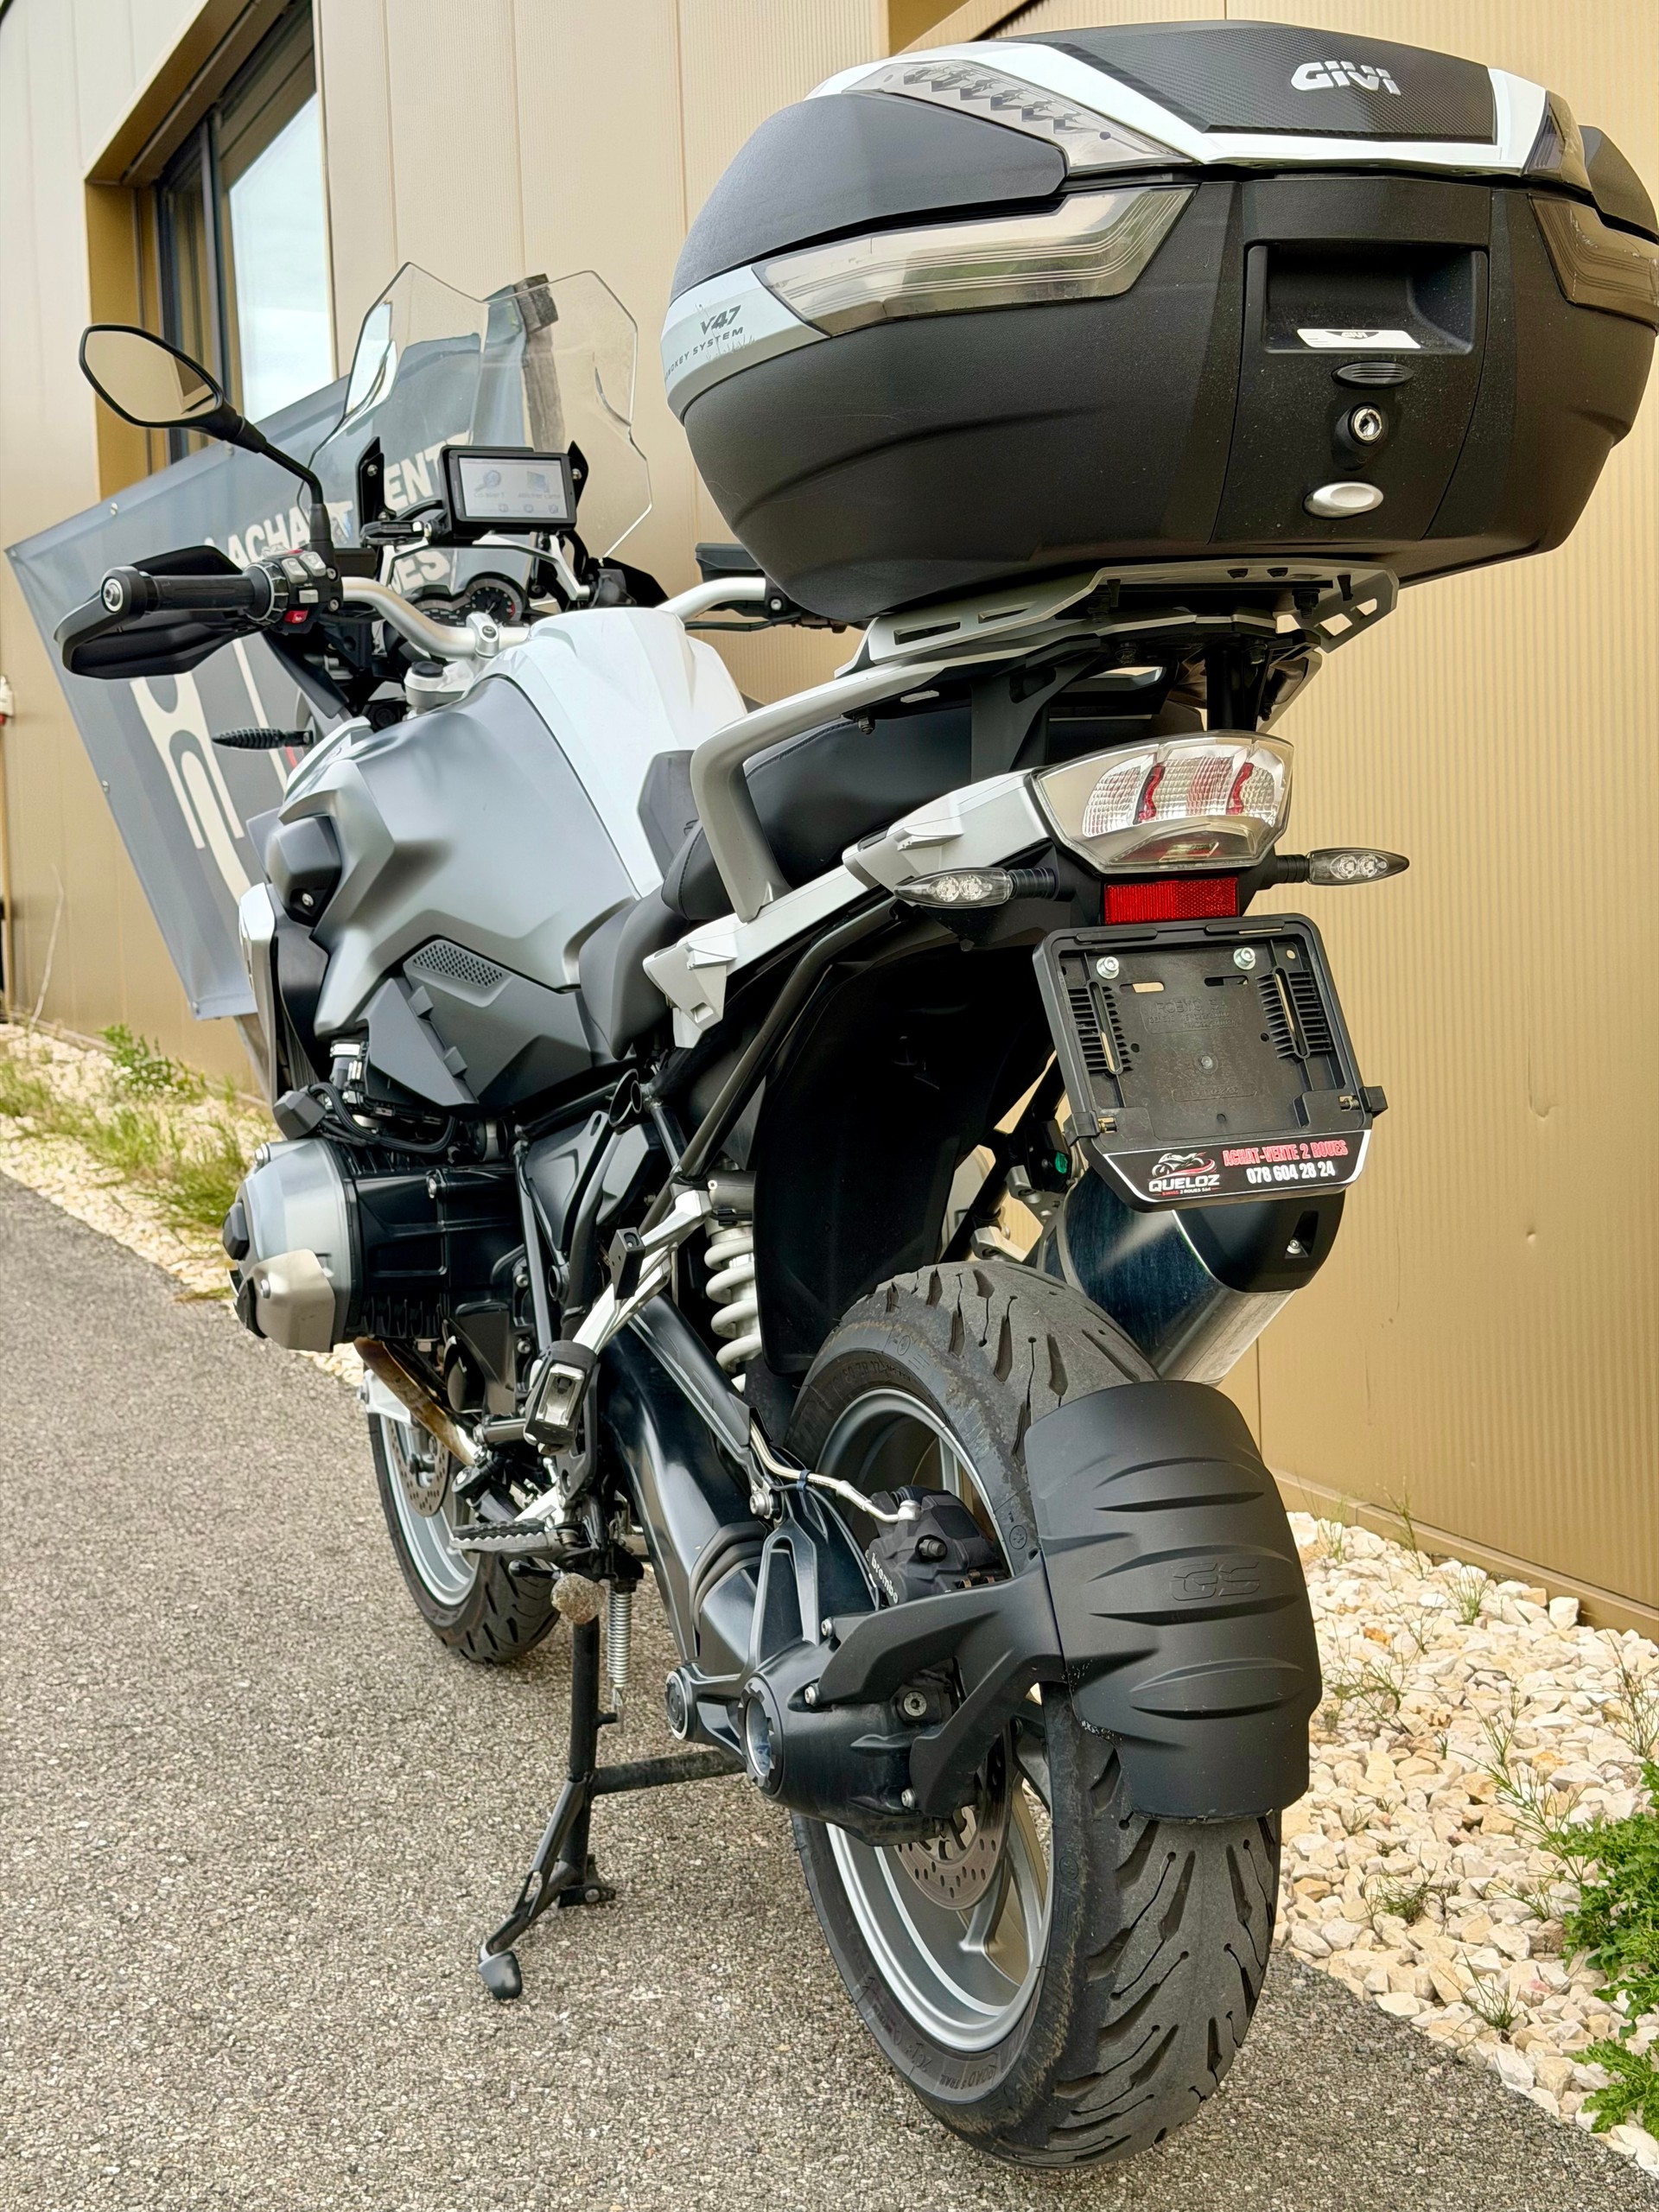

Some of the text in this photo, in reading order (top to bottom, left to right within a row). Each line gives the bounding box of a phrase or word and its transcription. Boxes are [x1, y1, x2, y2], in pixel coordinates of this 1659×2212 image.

[700, 305, 741, 334] V47
[692, 326, 744, 356] SYSTEM
[1223, 1139, 1348, 1166] ACHAT-VENTE 2 ROUES
[1148, 1174, 1220, 1192] QUELOZ
[1246, 1160, 1336, 1184] 078 604 28 24
[871, 1552, 899, 1605] brembo
[1170, 1561, 1261, 1601] GS
